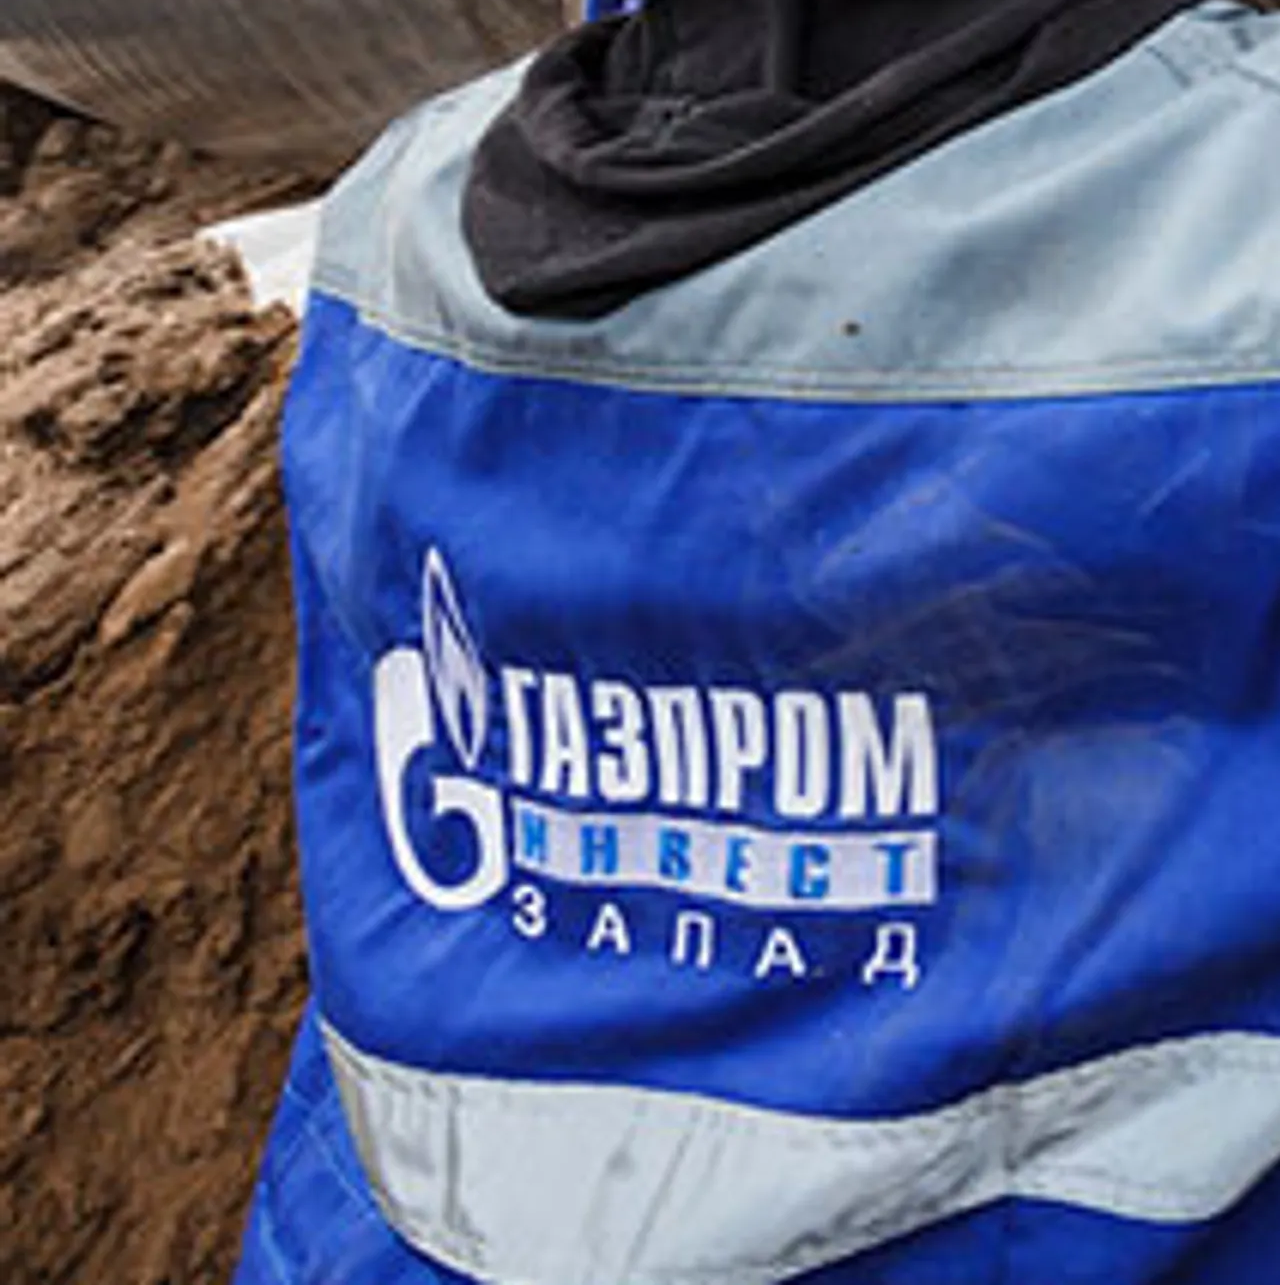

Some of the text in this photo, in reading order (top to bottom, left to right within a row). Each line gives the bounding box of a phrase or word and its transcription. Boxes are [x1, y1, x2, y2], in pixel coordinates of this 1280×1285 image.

[501, 666, 939, 818] ГАЗПРОМ
[515, 809, 918, 899] ИНВЕСТ
[511, 885, 920, 989] ЗАПАД
